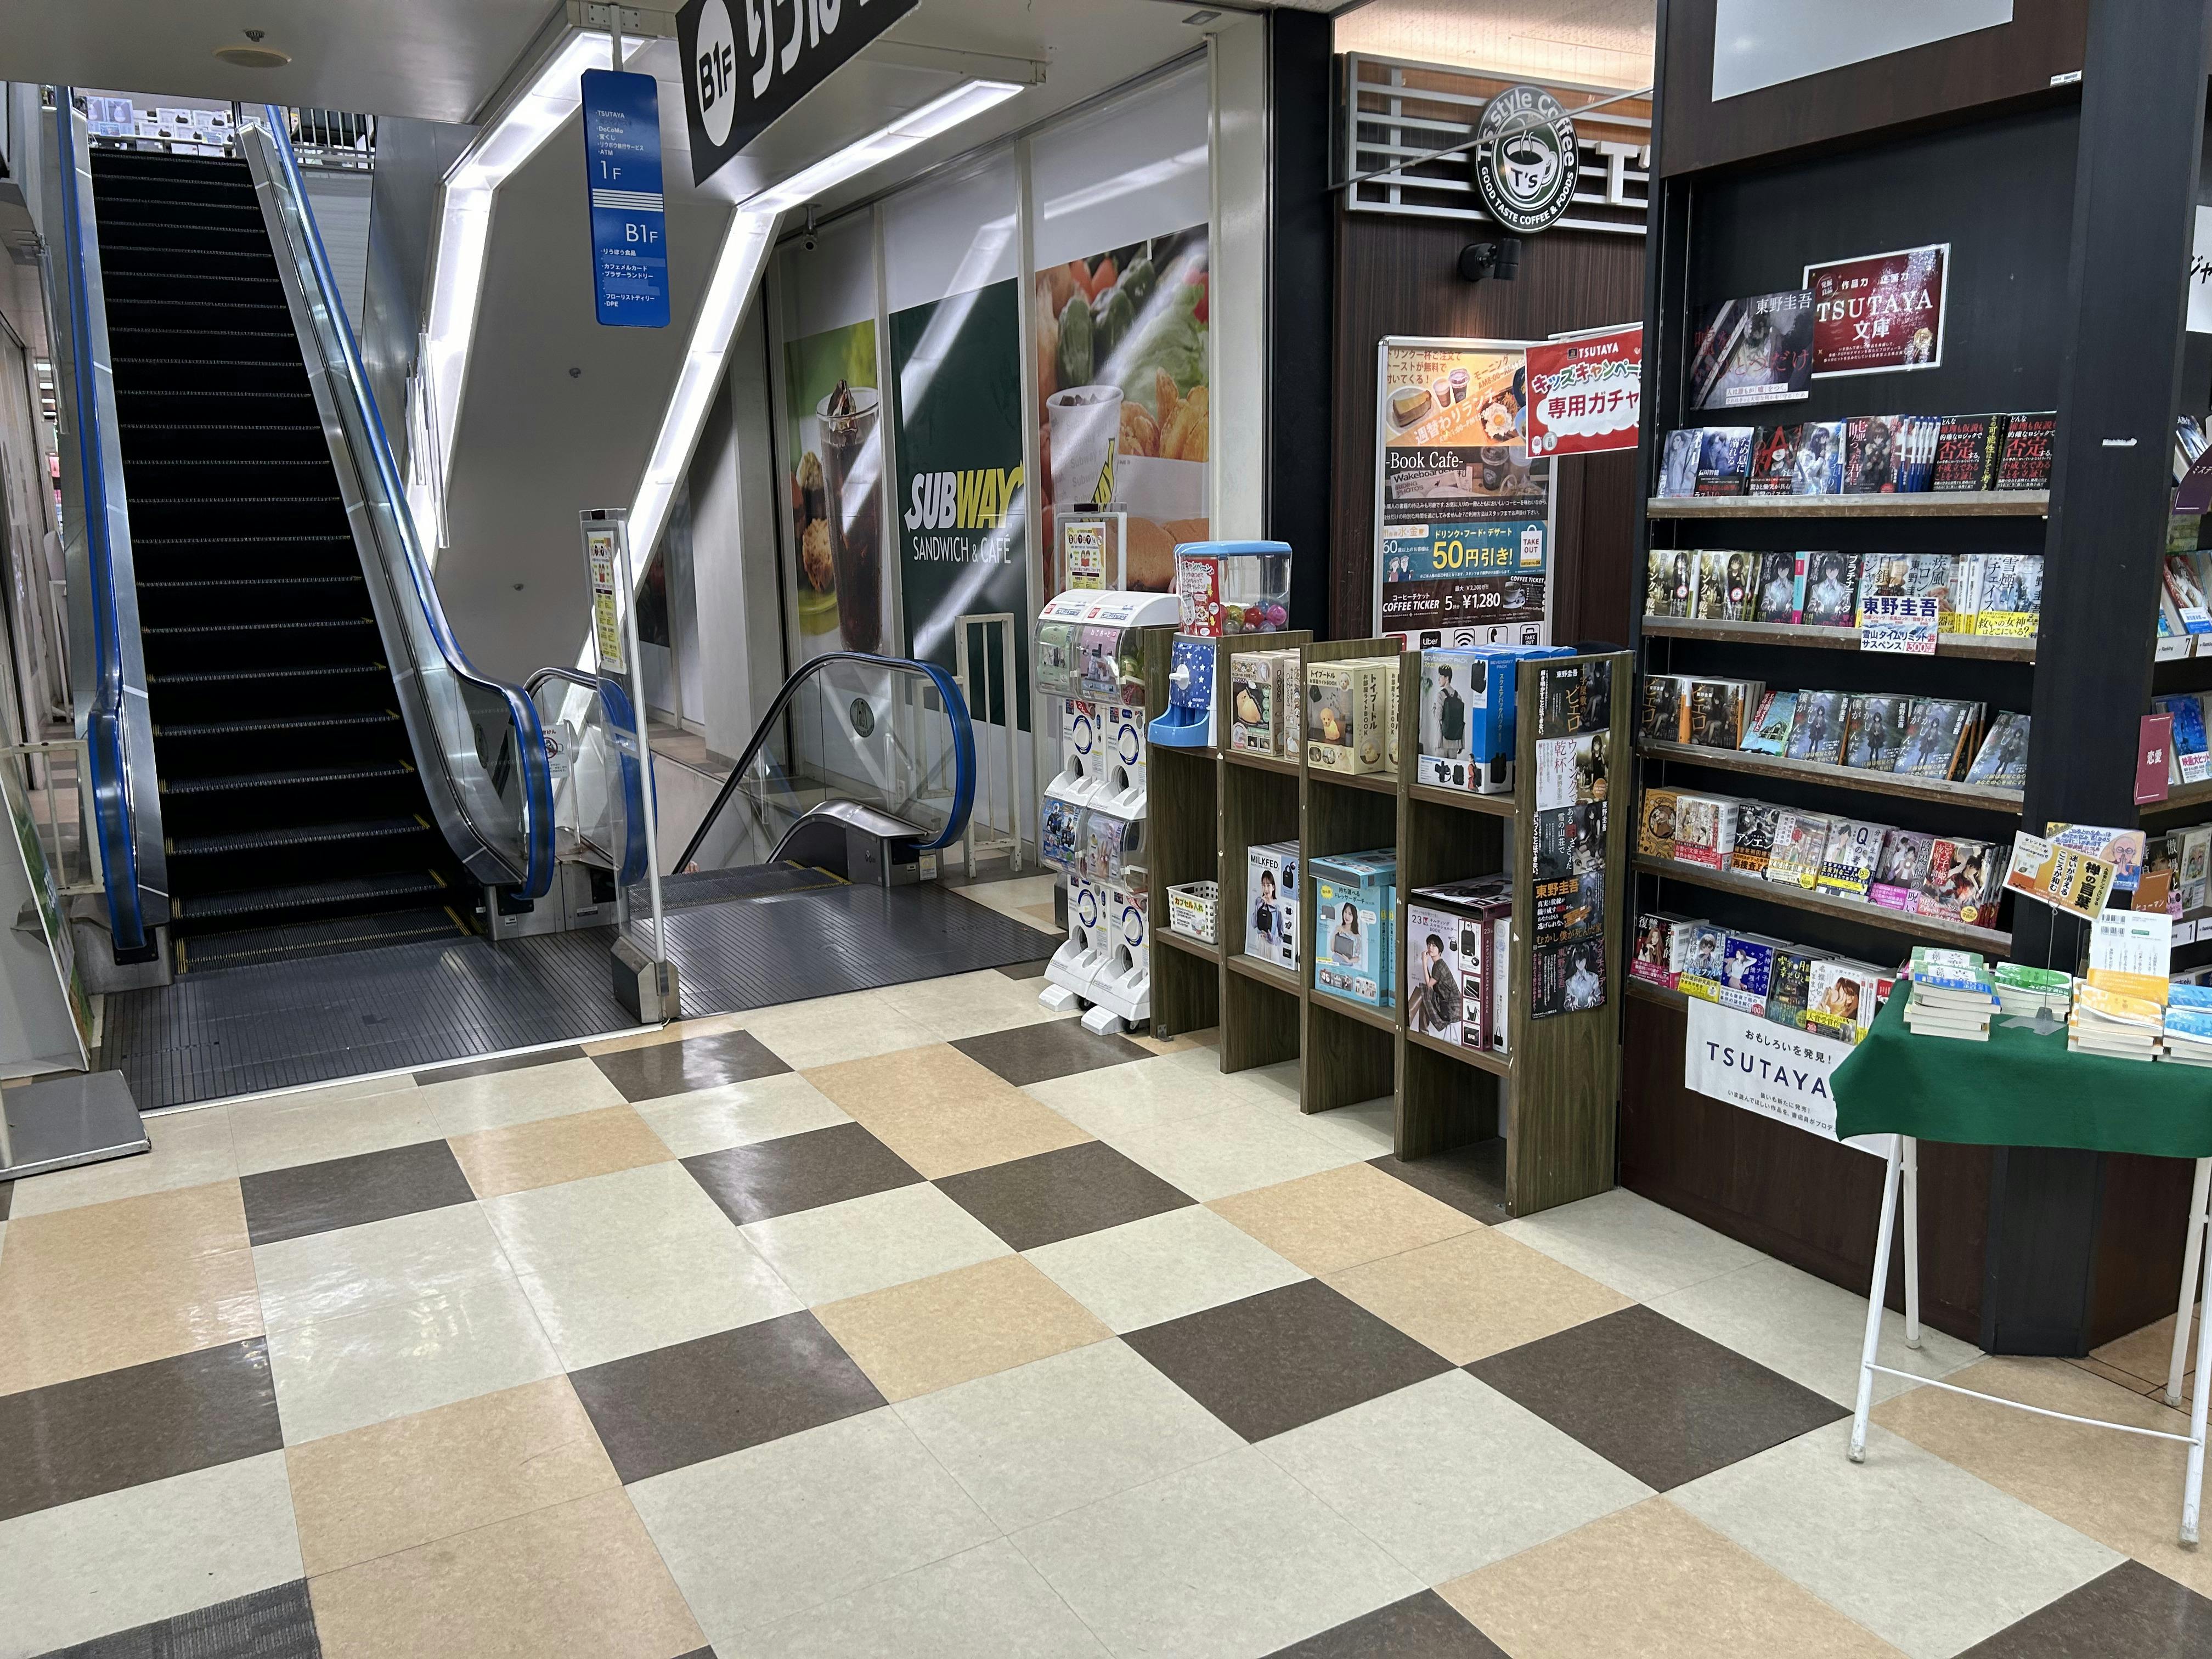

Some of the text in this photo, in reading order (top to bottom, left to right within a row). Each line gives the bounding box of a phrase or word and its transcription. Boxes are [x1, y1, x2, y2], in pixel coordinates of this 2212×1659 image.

[699, 41, 732, 112] B1F
[1491, 89, 1532, 128] style
[1538, 95, 1575, 167] Coffee
[1482, 167, 1574, 225] GOOD TASTE COFFEE & FOODS
[626, 223, 658, 243] B1F
[1756, 292, 1812, 315] 東野圭吾
[1816, 289, 1933, 323] TSUTAYA
[1852, 318, 1891, 341] 文庫
[1579, 342, 1619, 358] TSUTAYA
[1474, 354, 1510, 380] モーニング
[1532, 358, 1641, 394] キッズキャンペー
[1414, 387, 1497, 445] 週替わりランチ
[1548, 389, 1639, 419] 専用ガチャ
[904, 459, 1024, 533] SUBWAY
[913, 534, 1011, 563] SANDWICH & CAFÉ
[1842, 555, 1858, 613] プラチナデータ
[1875, 555, 1891, 585] 白銀
[1931, 555, 1947, 586] 疾風
[1999, 557, 2018, 592] 雪煙
[1983, 561, 2001, 611] チェイス
[1383, 601, 1412, 612] COFFEE
[1863, 597, 1937, 617] 東野圭吾
[1863, 630, 1927, 641] 雪山タイムリミット
[1978, 617, 2025, 629] 救いの女神
[1862, 640, 1901, 650] サスペンス
[2185, 637, 2191, 655] 7
[1311, 670, 1335, 679] トイプードル
[1556, 669, 1578, 678] 東野圭吾
[1369, 674, 1378, 730] トイプードル
[1566, 685, 1581, 732] ピエロ
[1554, 741, 1566, 773] 乾杯
[1568, 739, 1579, 803] ウインクで
[2147, 749, 2162, 764] 恋愛
[2182, 754, 2210, 766] 映画大ヒット
[2050, 851, 2066, 891] こころが和む
[2061, 854, 2079, 895] 迷いが消える
[2074, 861, 2101, 910] 禅の言葉
[1334, 893, 1365, 904] ドレッサーポーチ
[1339, 887, 1360, 897] 持ち運べる
[1536, 878, 1579, 899] 東野圭吾
[1175, 896, 1204, 912] カプセル入れ
[2136, 900, 2164, 911] ヒューマン
[1430, 923, 1457, 932] スマホショルダー
[2189, 924, 2192, 940] 1
[1558, 949, 1566, 988] 東野圭吾
[1597, 938, 1606, 1004] プラチナデータ
[1706, 1041, 1826, 1098] TSUTAYA
